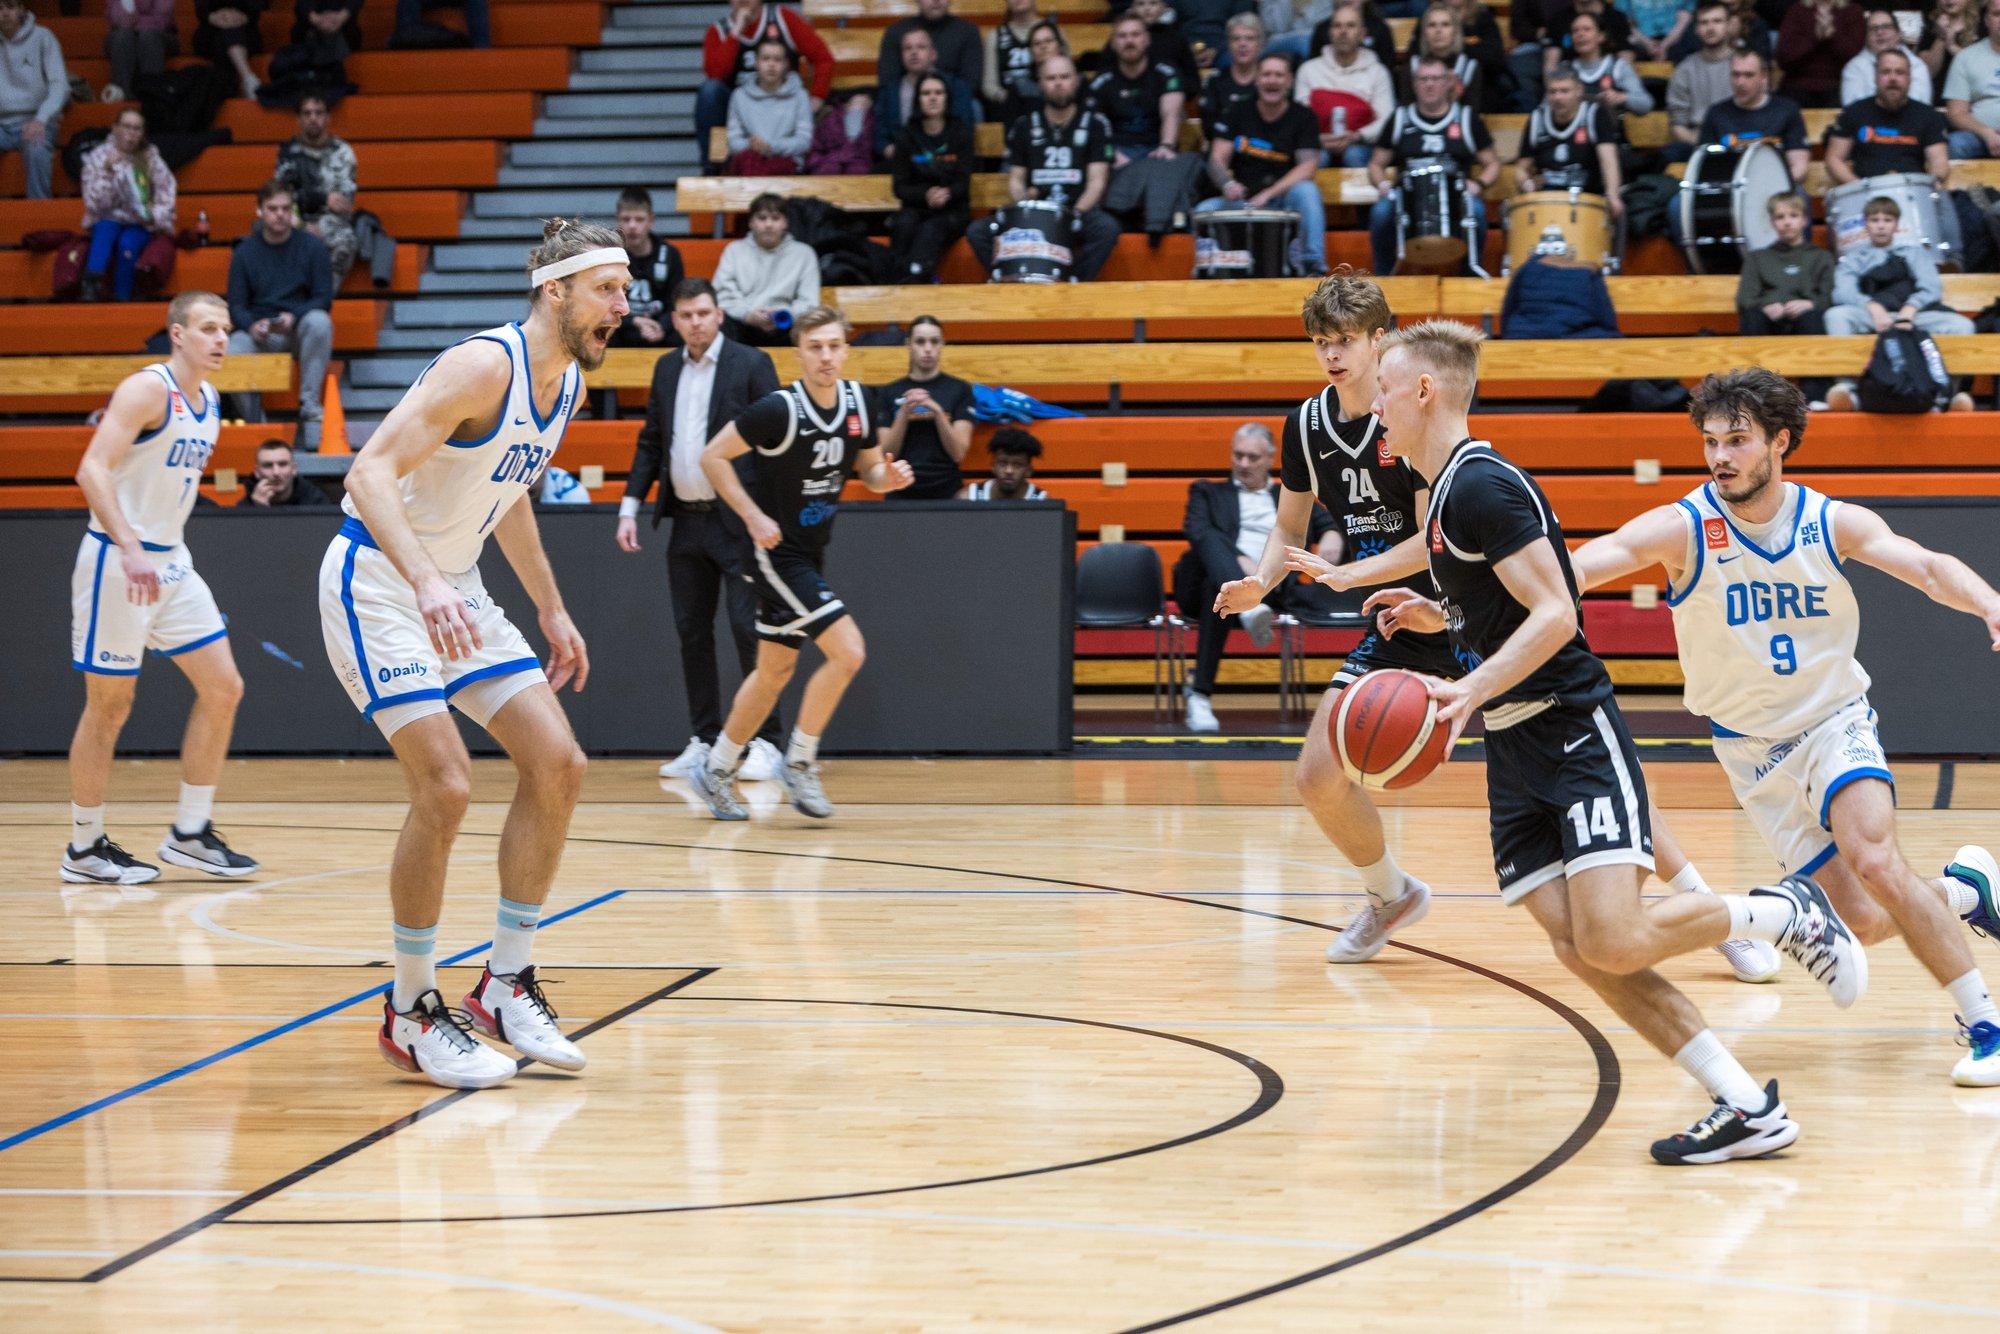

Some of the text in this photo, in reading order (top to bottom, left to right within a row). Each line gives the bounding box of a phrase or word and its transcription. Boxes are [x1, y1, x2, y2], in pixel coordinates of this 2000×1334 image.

[1311, 398, 1320, 431] TRIMTEX
[811, 437, 844, 469] 20
[1341, 467, 1380, 504] 24
[1346, 524, 1381, 536] PÄRNU
[1727, 581, 1830, 626] OGRE
[393, 662, 427, 678] Daily
[1770, 633, 1797, 675] 9
[1355, 682, 1385, 730] molten
[1567, 796, 1621, 847] 14
